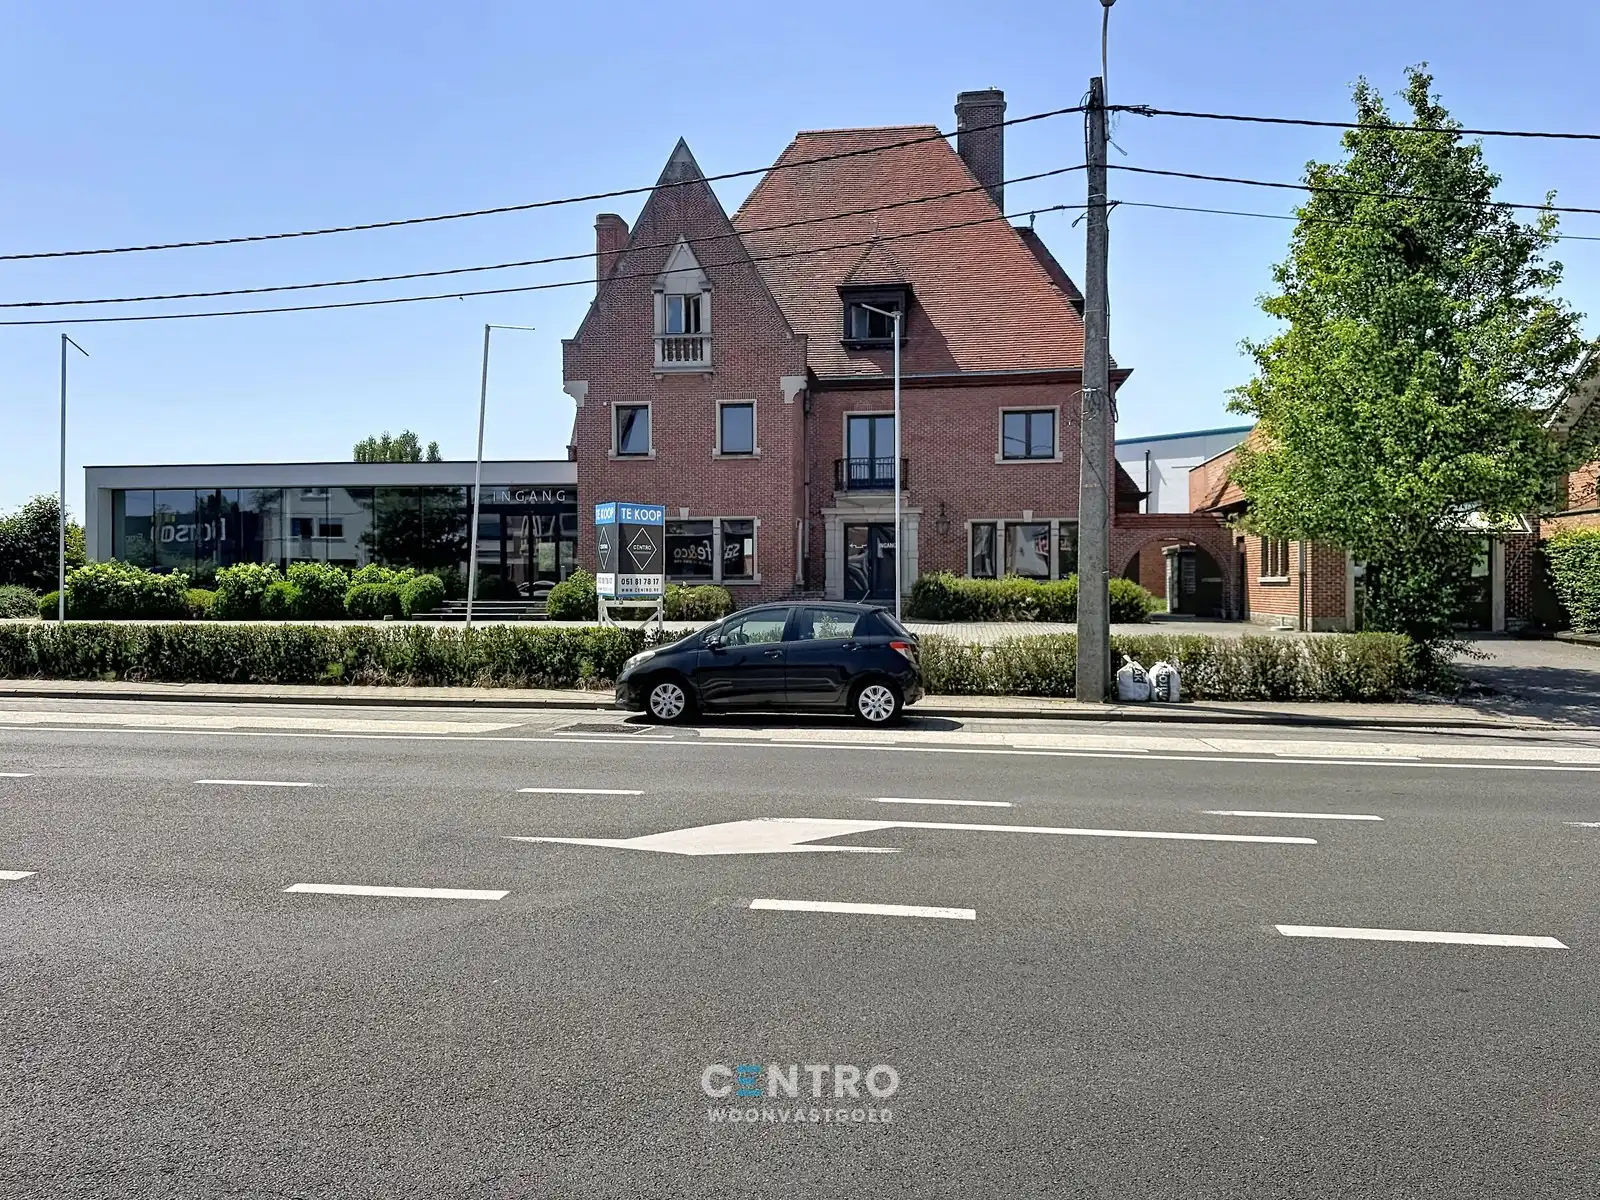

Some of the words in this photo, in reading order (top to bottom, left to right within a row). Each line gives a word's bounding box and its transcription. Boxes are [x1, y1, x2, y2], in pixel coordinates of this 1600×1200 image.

[493, 490, 566, 502] INGANG
[621, 508, 632, 519] TE
[634, 509, 661, 521] KOOP
